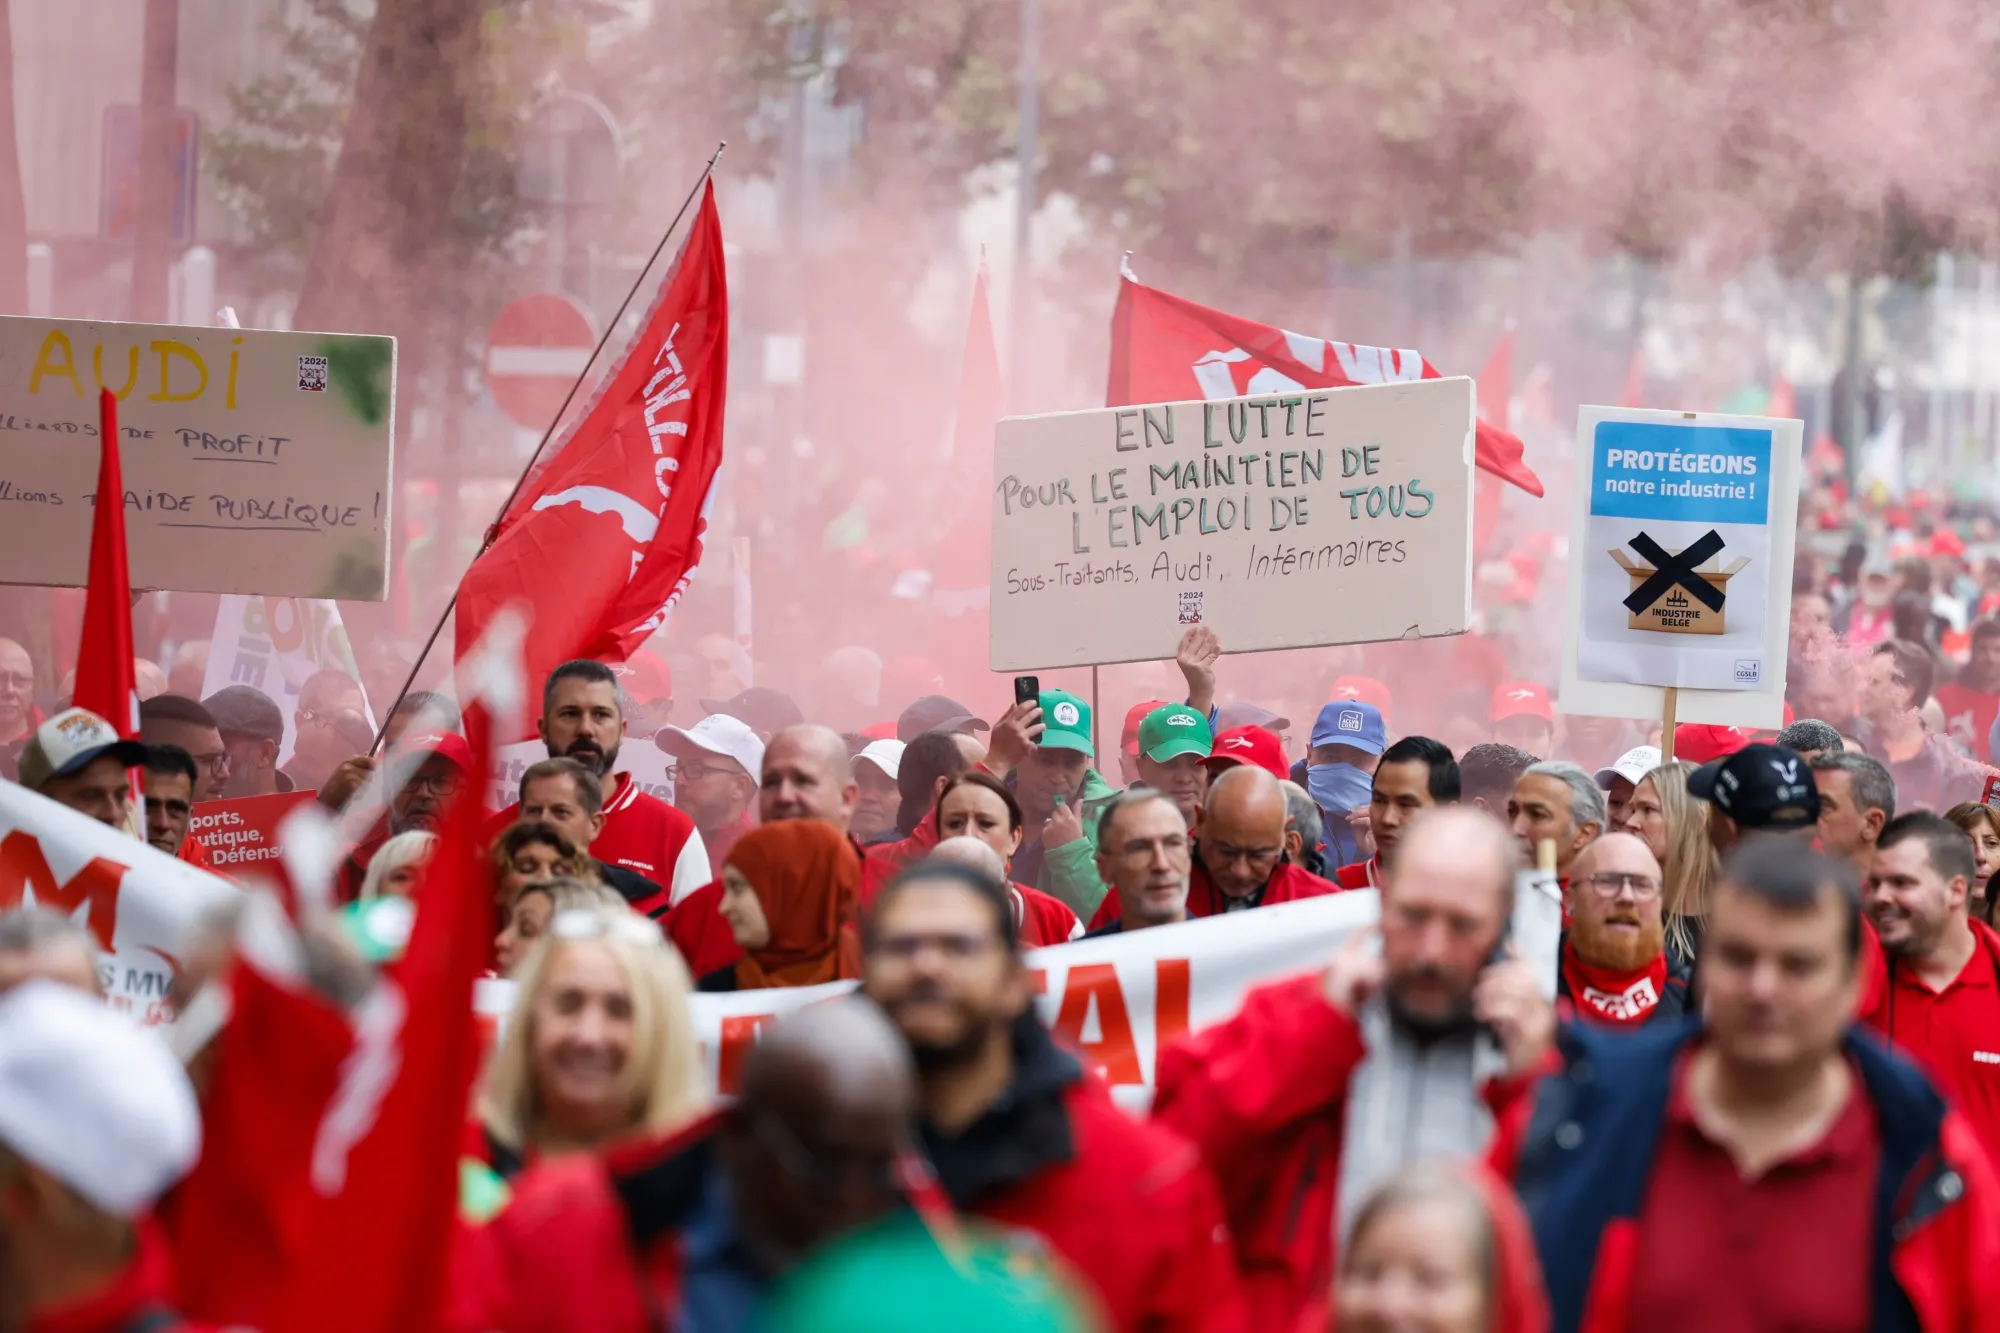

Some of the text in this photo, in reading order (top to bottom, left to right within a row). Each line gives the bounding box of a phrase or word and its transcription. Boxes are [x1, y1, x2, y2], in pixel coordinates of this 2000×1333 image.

[121, 427, 155, 439] DE
[1115, 397, 1328, 452] EN LUTTE
[1607, 448, 1757, 476] PROTÉGEONS
[997, 474, 1076, 515] POUR
[1091, 467, 1128, 504] LE
[1341, 444, 1381, 477] DE
[1605, 478, 1655, 495] notre
[1073, 479, 1435, 554] L'EMPLOI DE TOUS
[1007, 560, 1139, 595] Sous-Traitants,
[1247, 536, 1407, 580] Intérimaires
[1652, 608, 1700, 619] INDUSTRIE
[1661, 617, 1690, 627] BELGE
[193, 829, 265, 847] utique,
